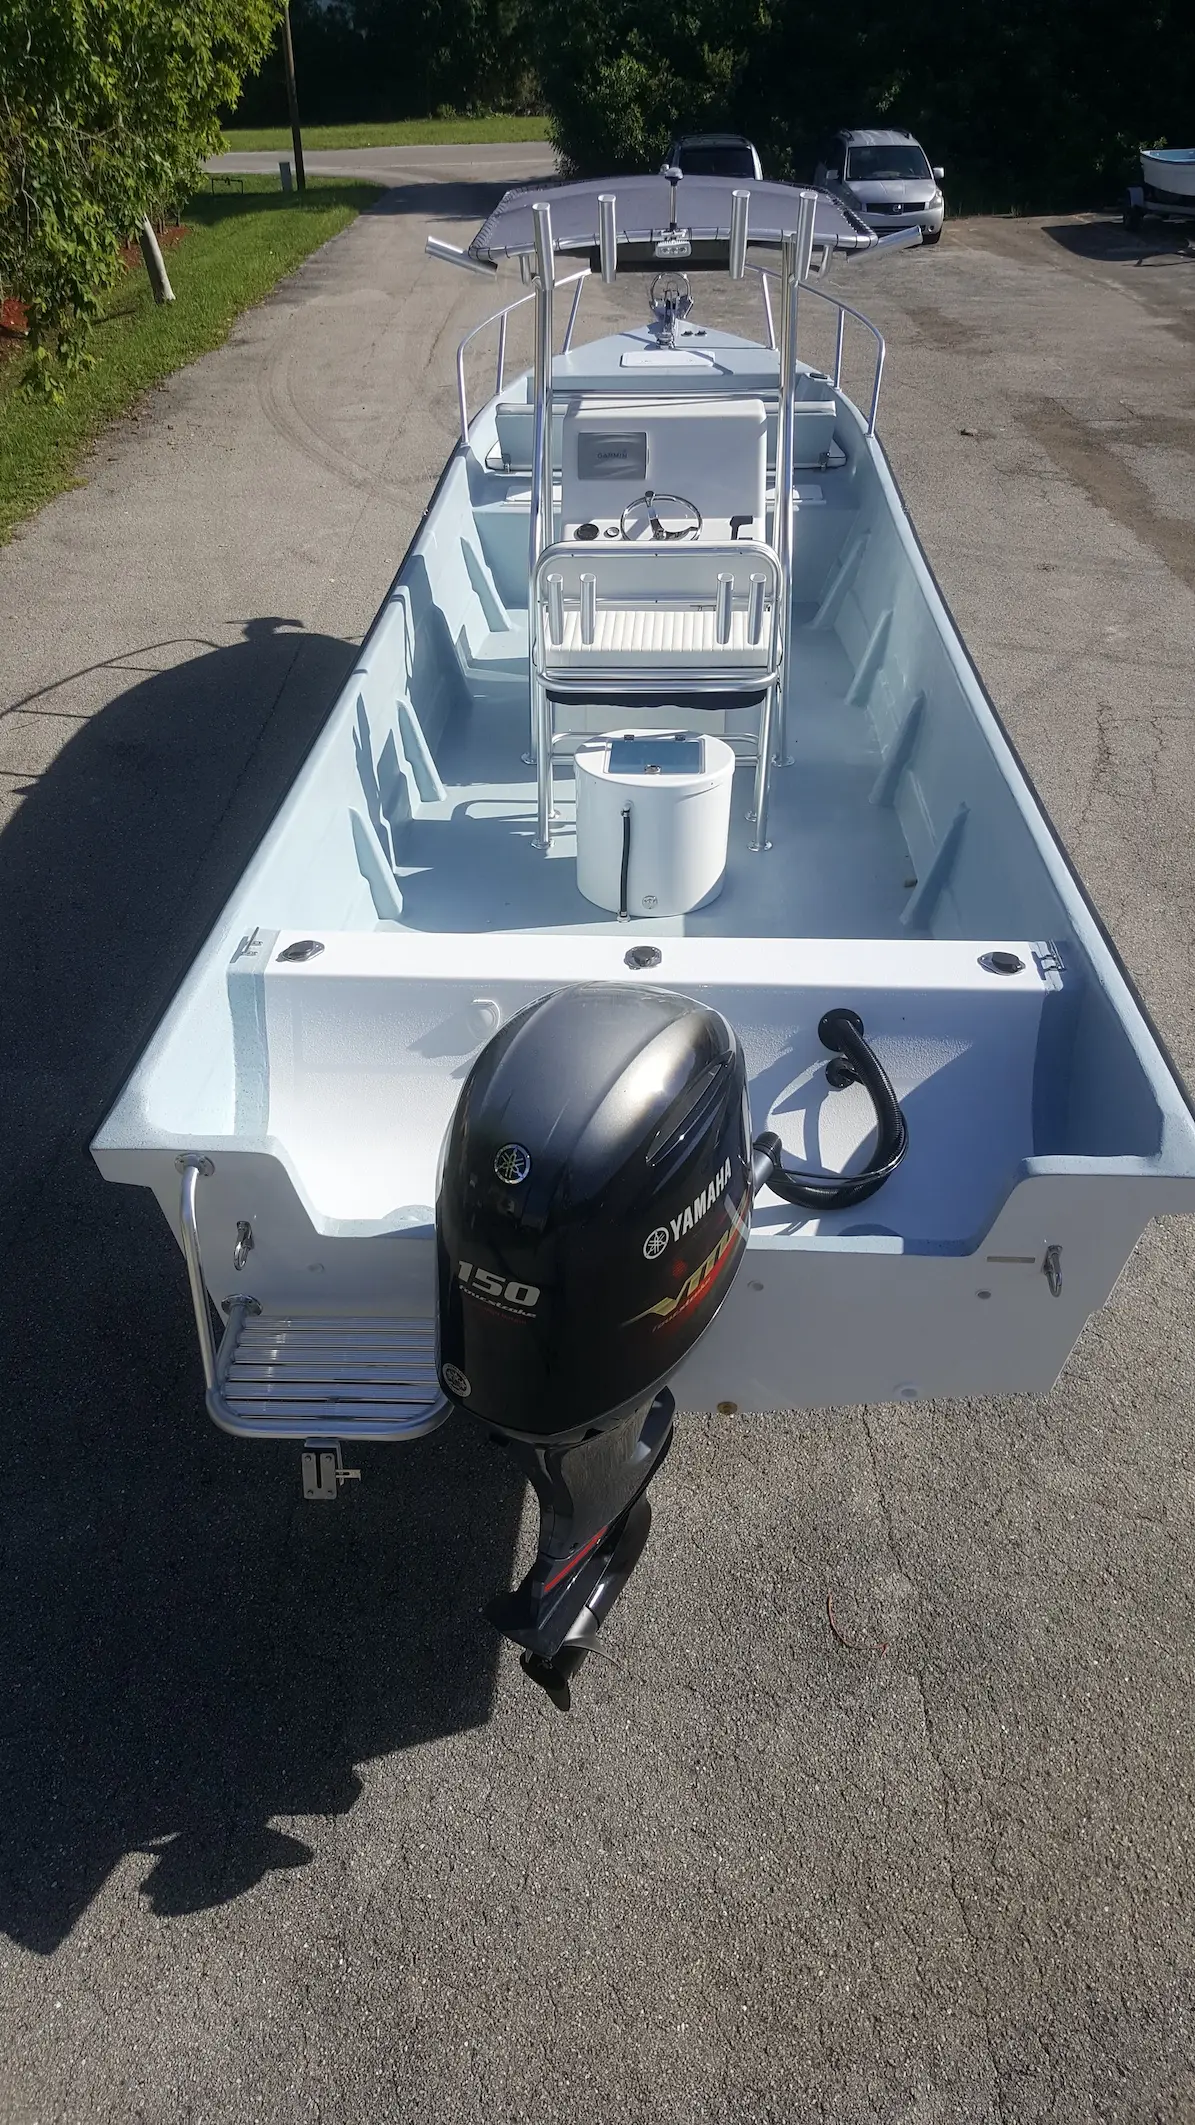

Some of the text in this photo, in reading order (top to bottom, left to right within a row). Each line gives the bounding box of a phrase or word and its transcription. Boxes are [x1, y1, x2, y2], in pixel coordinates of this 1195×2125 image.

[596, 451, 629, 460] GARMIN
[669, 1156, 732, 1242] YAMAHA
[458, 1260, 541, 1307] 150
